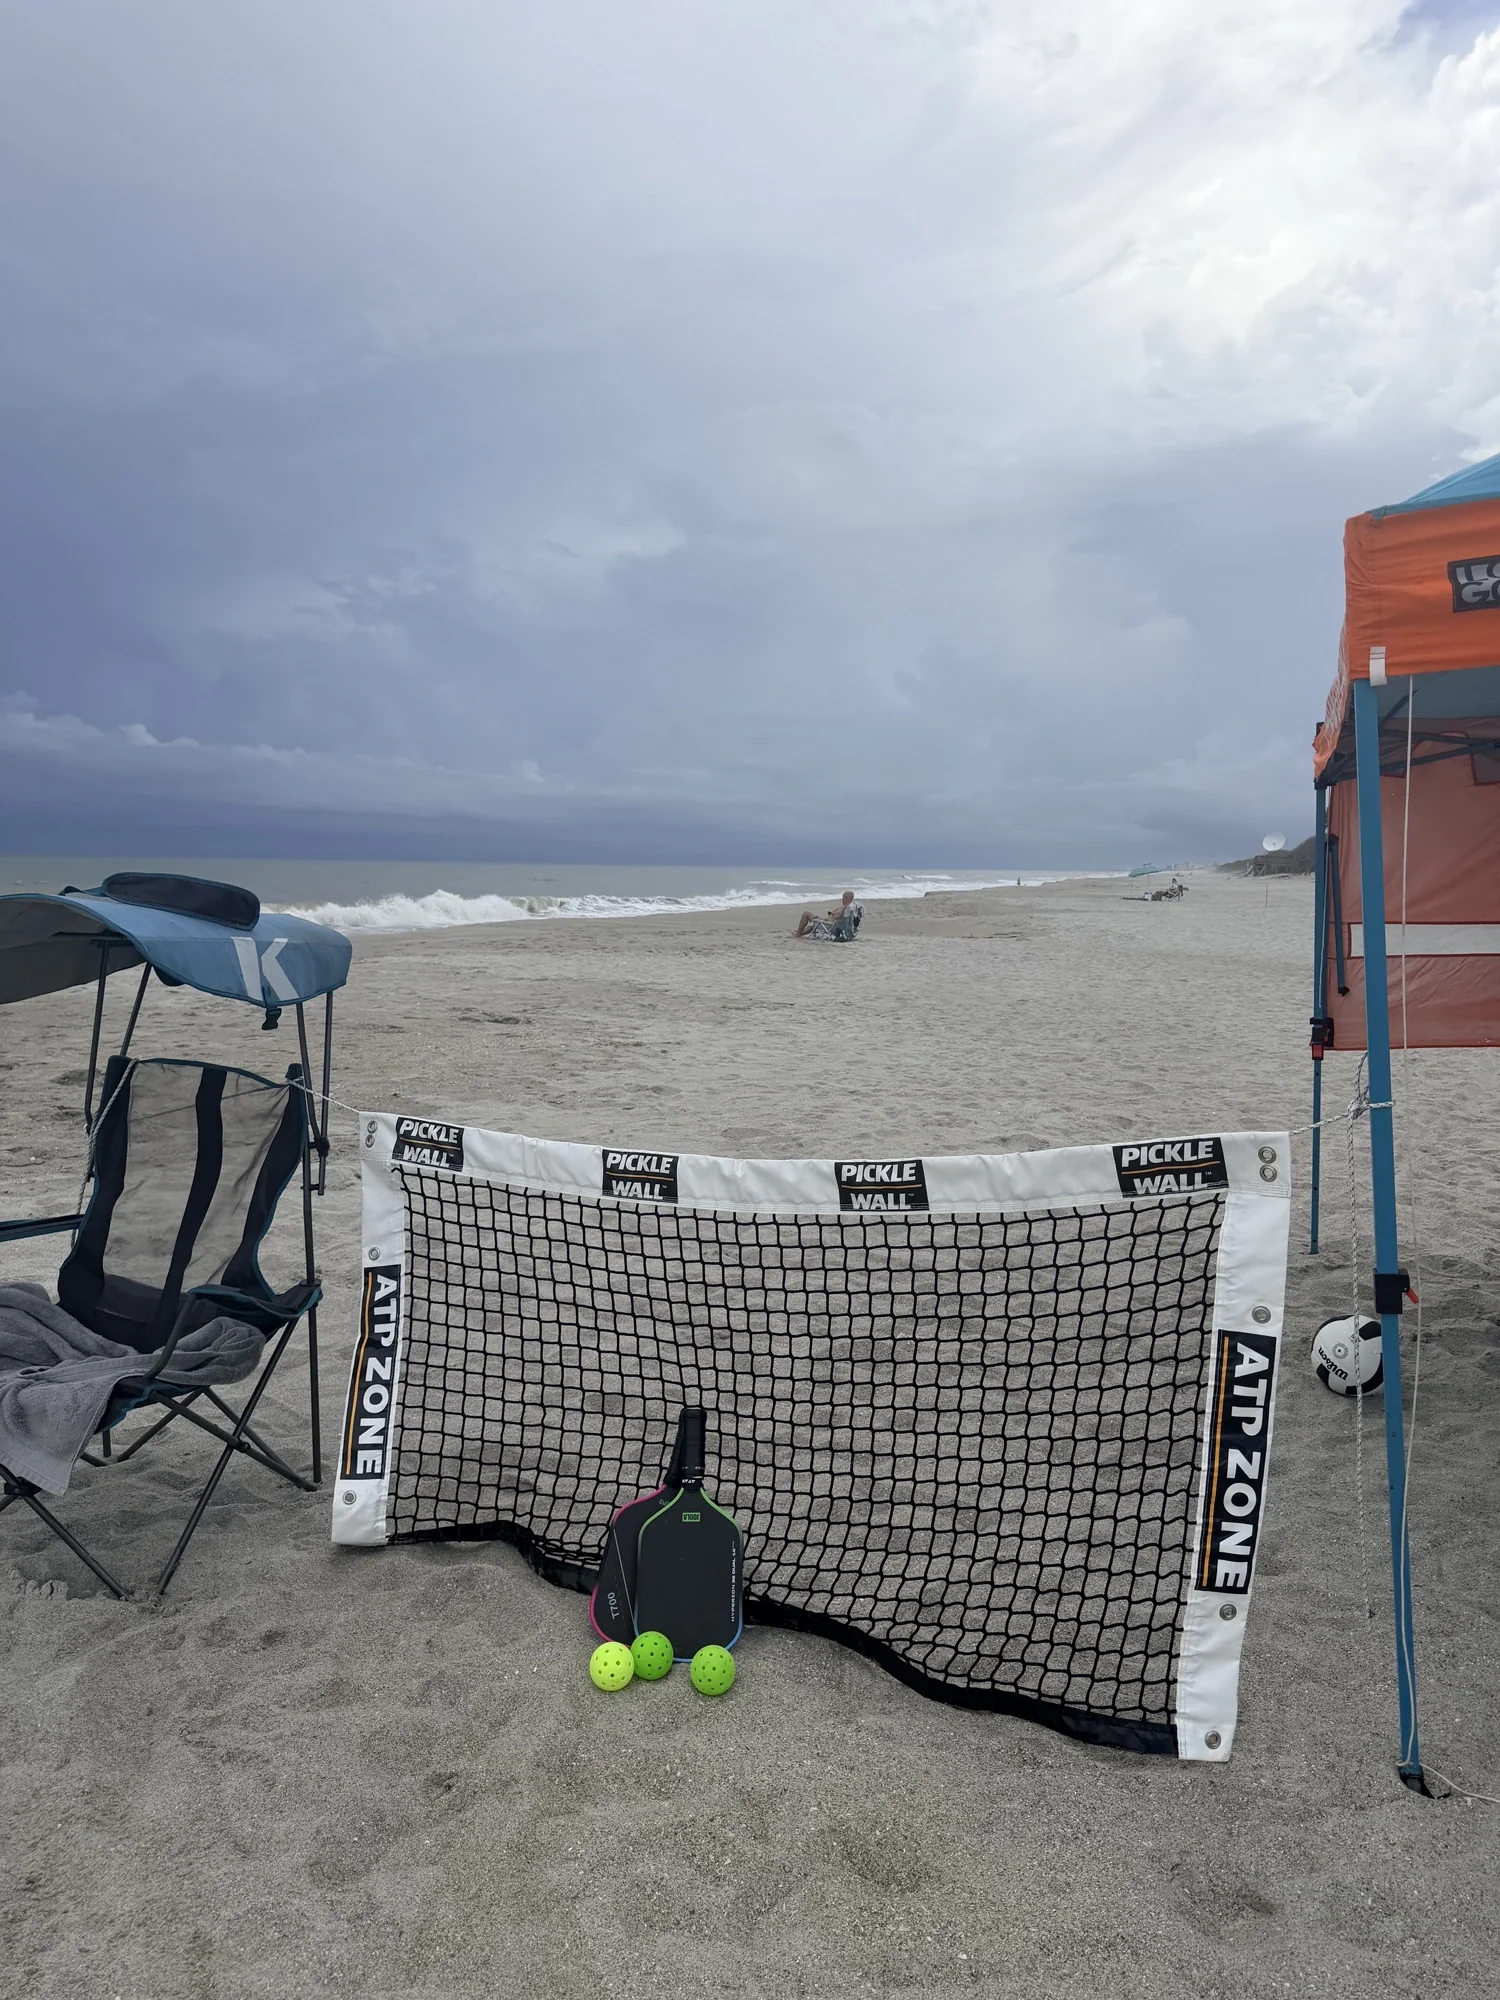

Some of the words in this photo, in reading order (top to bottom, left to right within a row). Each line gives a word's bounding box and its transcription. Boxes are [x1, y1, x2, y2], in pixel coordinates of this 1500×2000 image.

[399, 1119, 460, 1144] PICKLE
[402, 1144, 450, 1168] WALL
[606, 1152, 674, 1175] PICKLE
[1121, 1140, 1214, 1168] PICKLE
[841, 1162, 917, 1183] PICKLE
[1133, 1172, 1208, 1195] WALL
[611, 1179, 664, 1200] WALL
[850, 1192, 911, 1210] WALL
[373, 1273, 398, 1348] ATP
[1317, 1347, 1349, 1381] Wilson
[1231, 1341, 1270, 1437] ATP
[356, 1356, 393, 1475] ZONE
[683, 1513, 700, 1521] JOOLA
[1214, 1448, 1262, 1589] ZONE
[607, 1592, 620, 1620] T700
